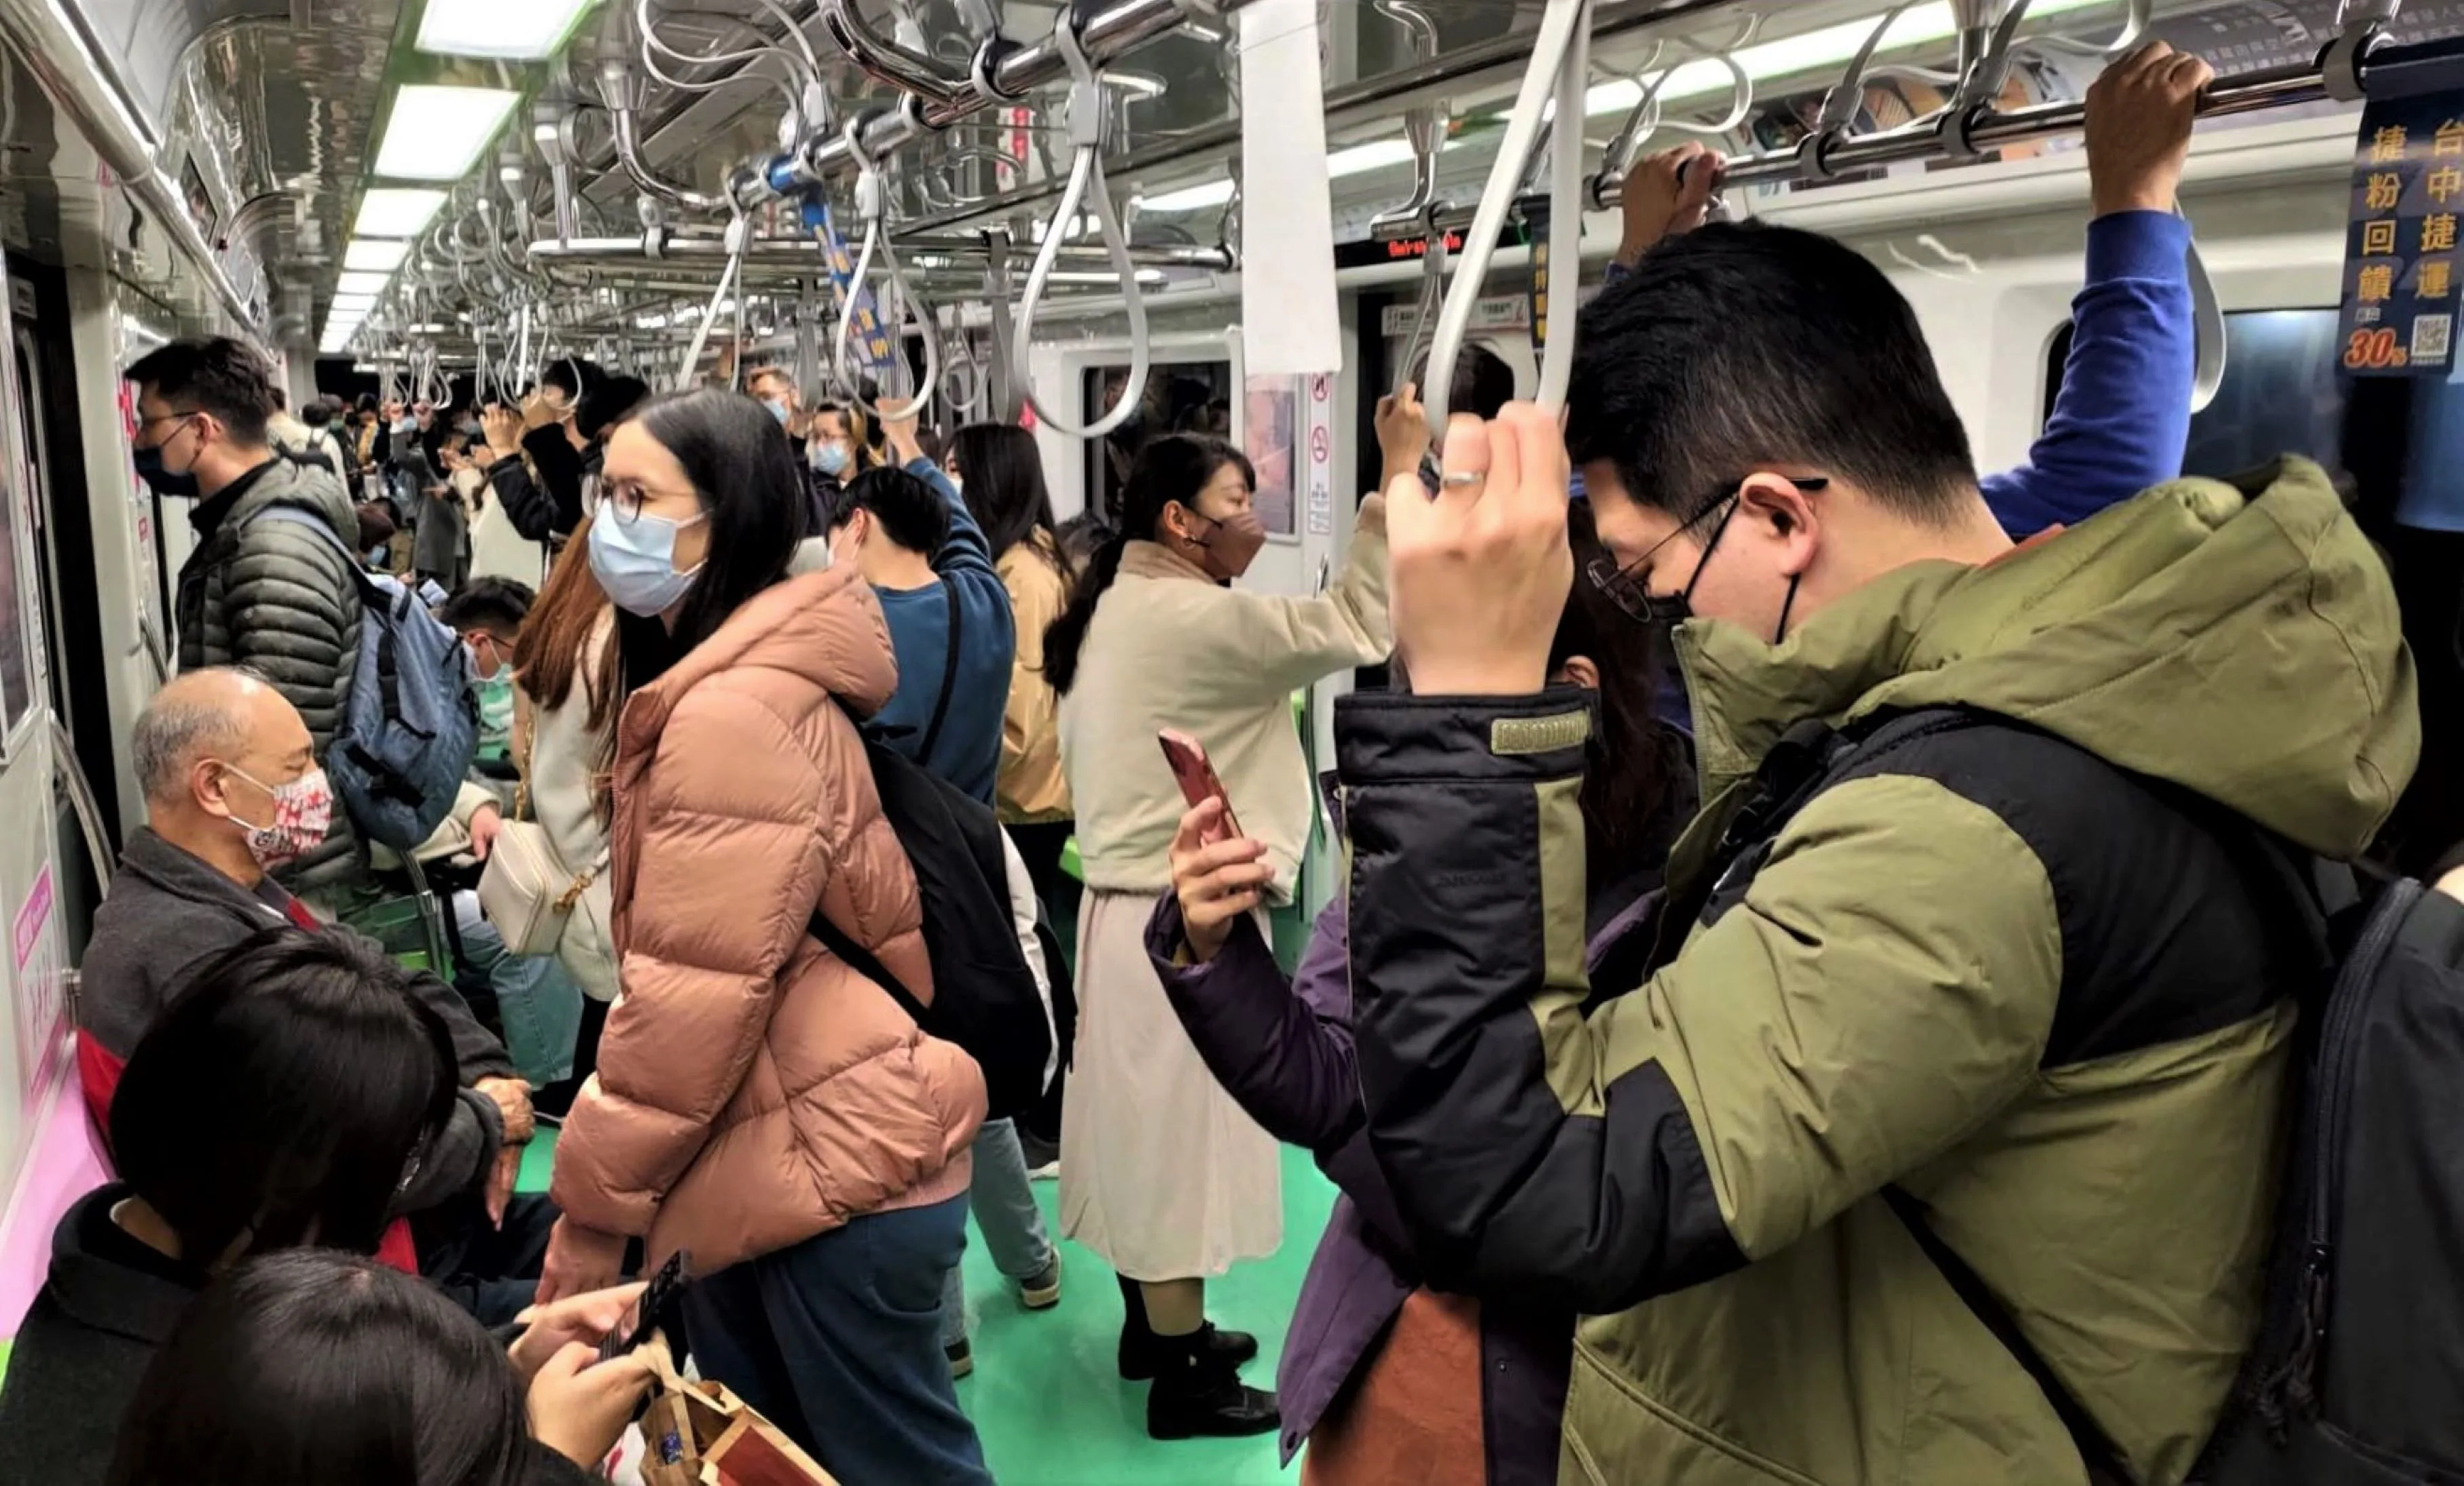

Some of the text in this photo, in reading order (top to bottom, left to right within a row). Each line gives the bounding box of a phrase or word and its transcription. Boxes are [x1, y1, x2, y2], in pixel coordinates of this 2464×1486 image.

[2358, 126, 2406, 300] 捷粉回饋
[2418, 120, 2464, 297] 台中捷運
